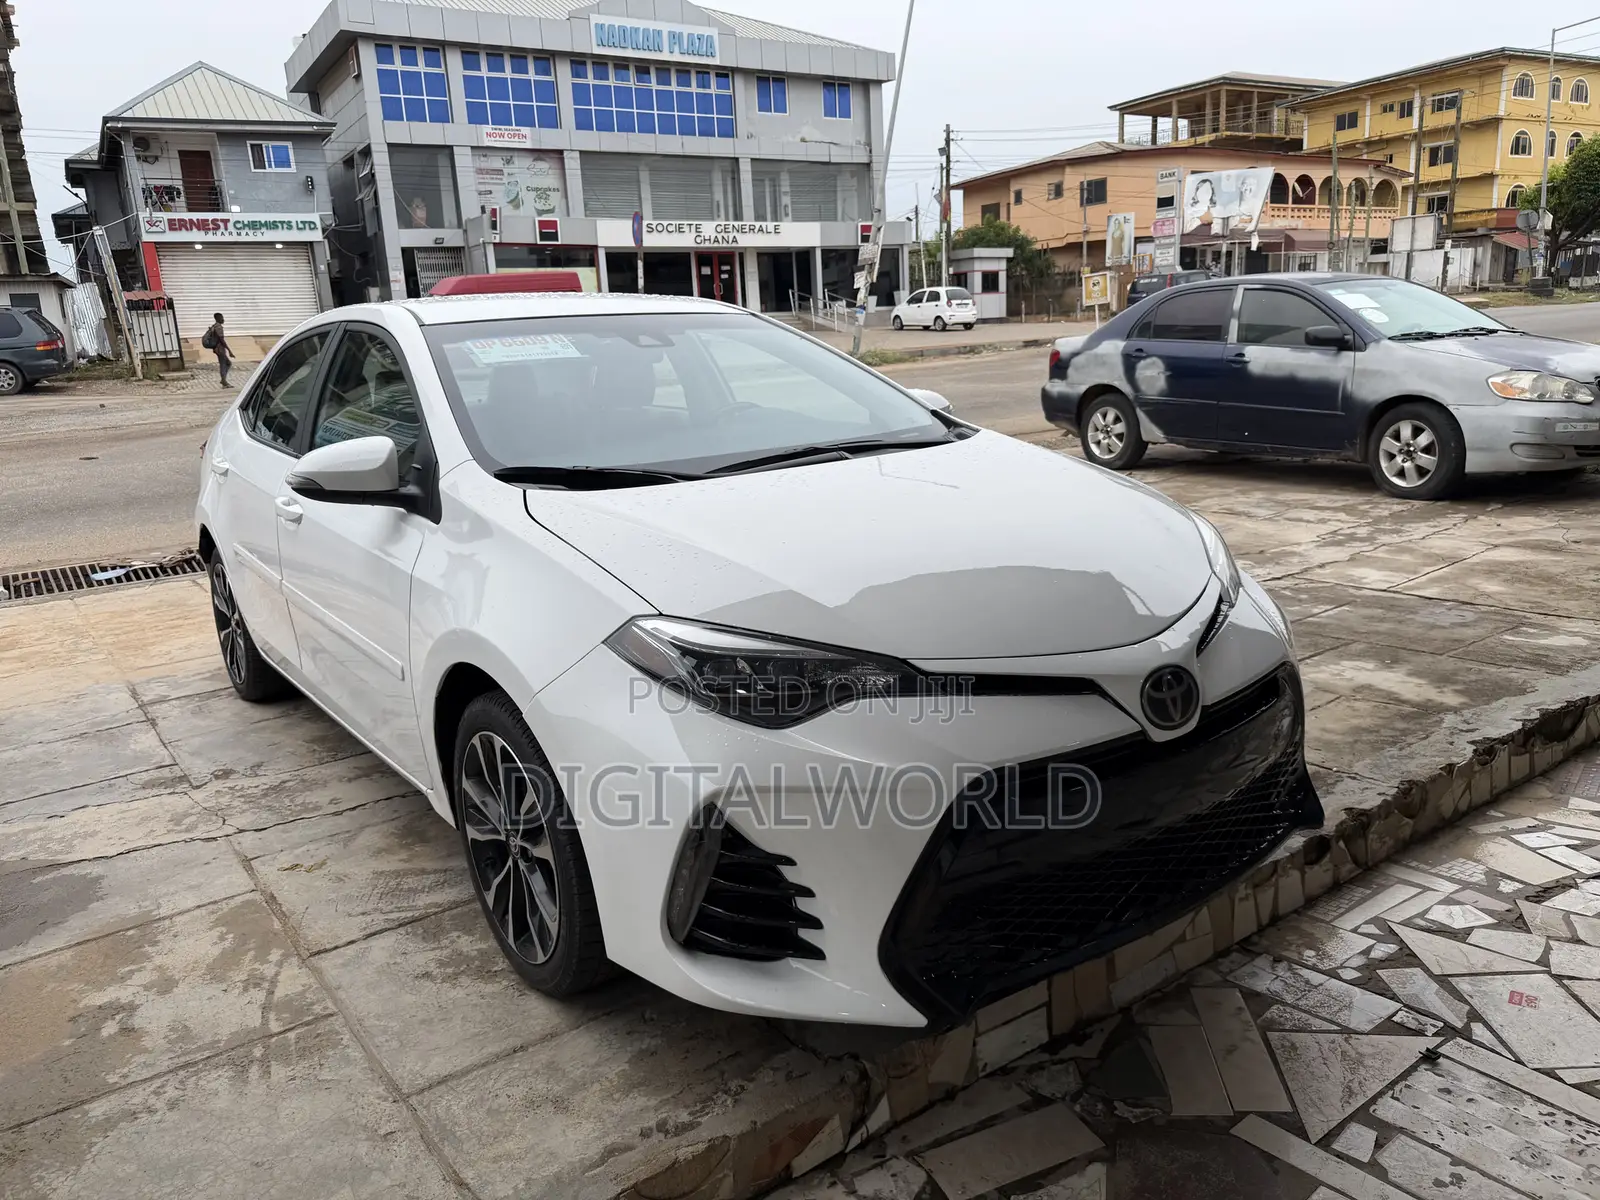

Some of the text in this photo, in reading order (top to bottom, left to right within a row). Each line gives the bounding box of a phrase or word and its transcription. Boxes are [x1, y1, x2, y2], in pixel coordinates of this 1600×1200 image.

[667, 30, 717, 58] PLAZA
[1159, 171, 1177, 180] BANK
[167, 218, 231, 232] ERNEST
[232, 220, 294, 231] CHEMISTS
[295, 221, 319, 231] LTD.
[645, 222, 781, 235] SOCIETE GENERALE
[693, 234, 739, 246] GHANA
